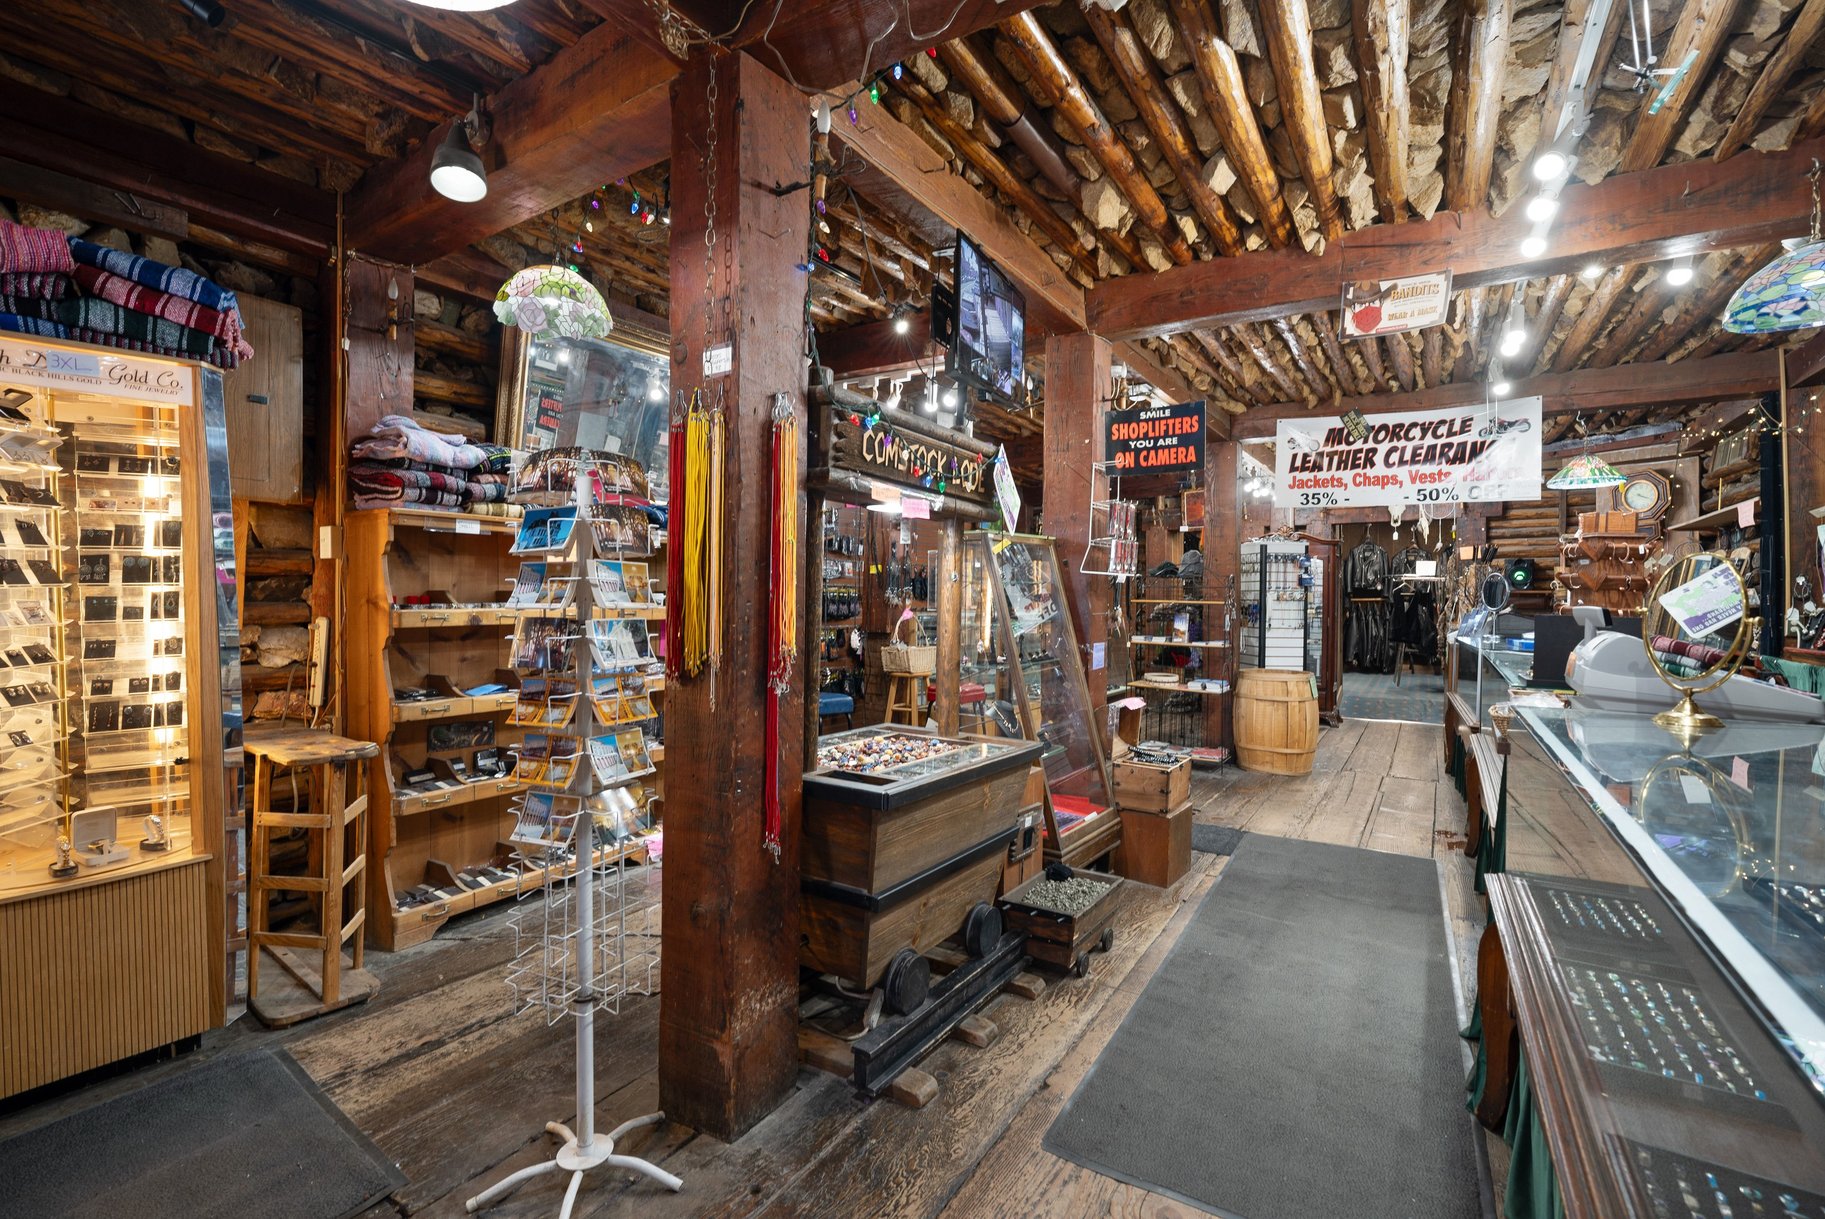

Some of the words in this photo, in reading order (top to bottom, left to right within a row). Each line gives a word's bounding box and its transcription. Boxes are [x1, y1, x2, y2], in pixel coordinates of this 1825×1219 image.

[1391, 284, 1440, 300] BANDITS
[52, 353, 92, 371] 3XL
[12, 368, 45, 378] BLACK
[48, 372, 74, 382] HILLS
[108, 364, 148, 384] Gold
[157, 371, 184, 388] Co.
[124, 384, 142, 392] FINE
[1140, 409, 1170, 419] SMILE
[1112, 415, 1198, 440] SHOPLIFTERS
[1322, 416, 1474, 448] MOTORCYCLE
[1129, 440, 1154, 448] YOU
[1157, 437, 1178, 446] ARE
[862, 430, 946, 478] COMSTOCK
[952, 456, 985, 493] LODE
[1115, 451, 1135, 468] ON
[1140, 446, 1196, 467] CAMERA
[1288, 447, 1378, 474] LEATHER
[1384, 440, 1499, 468] CLEARAN
[1288, 474, 1348, 491] Jackets,
[1352, 472, 1403, 490] Chaps,
[1300, 492, 1338, 505] 35%
[1416, 487, 1458, 501] 50%
